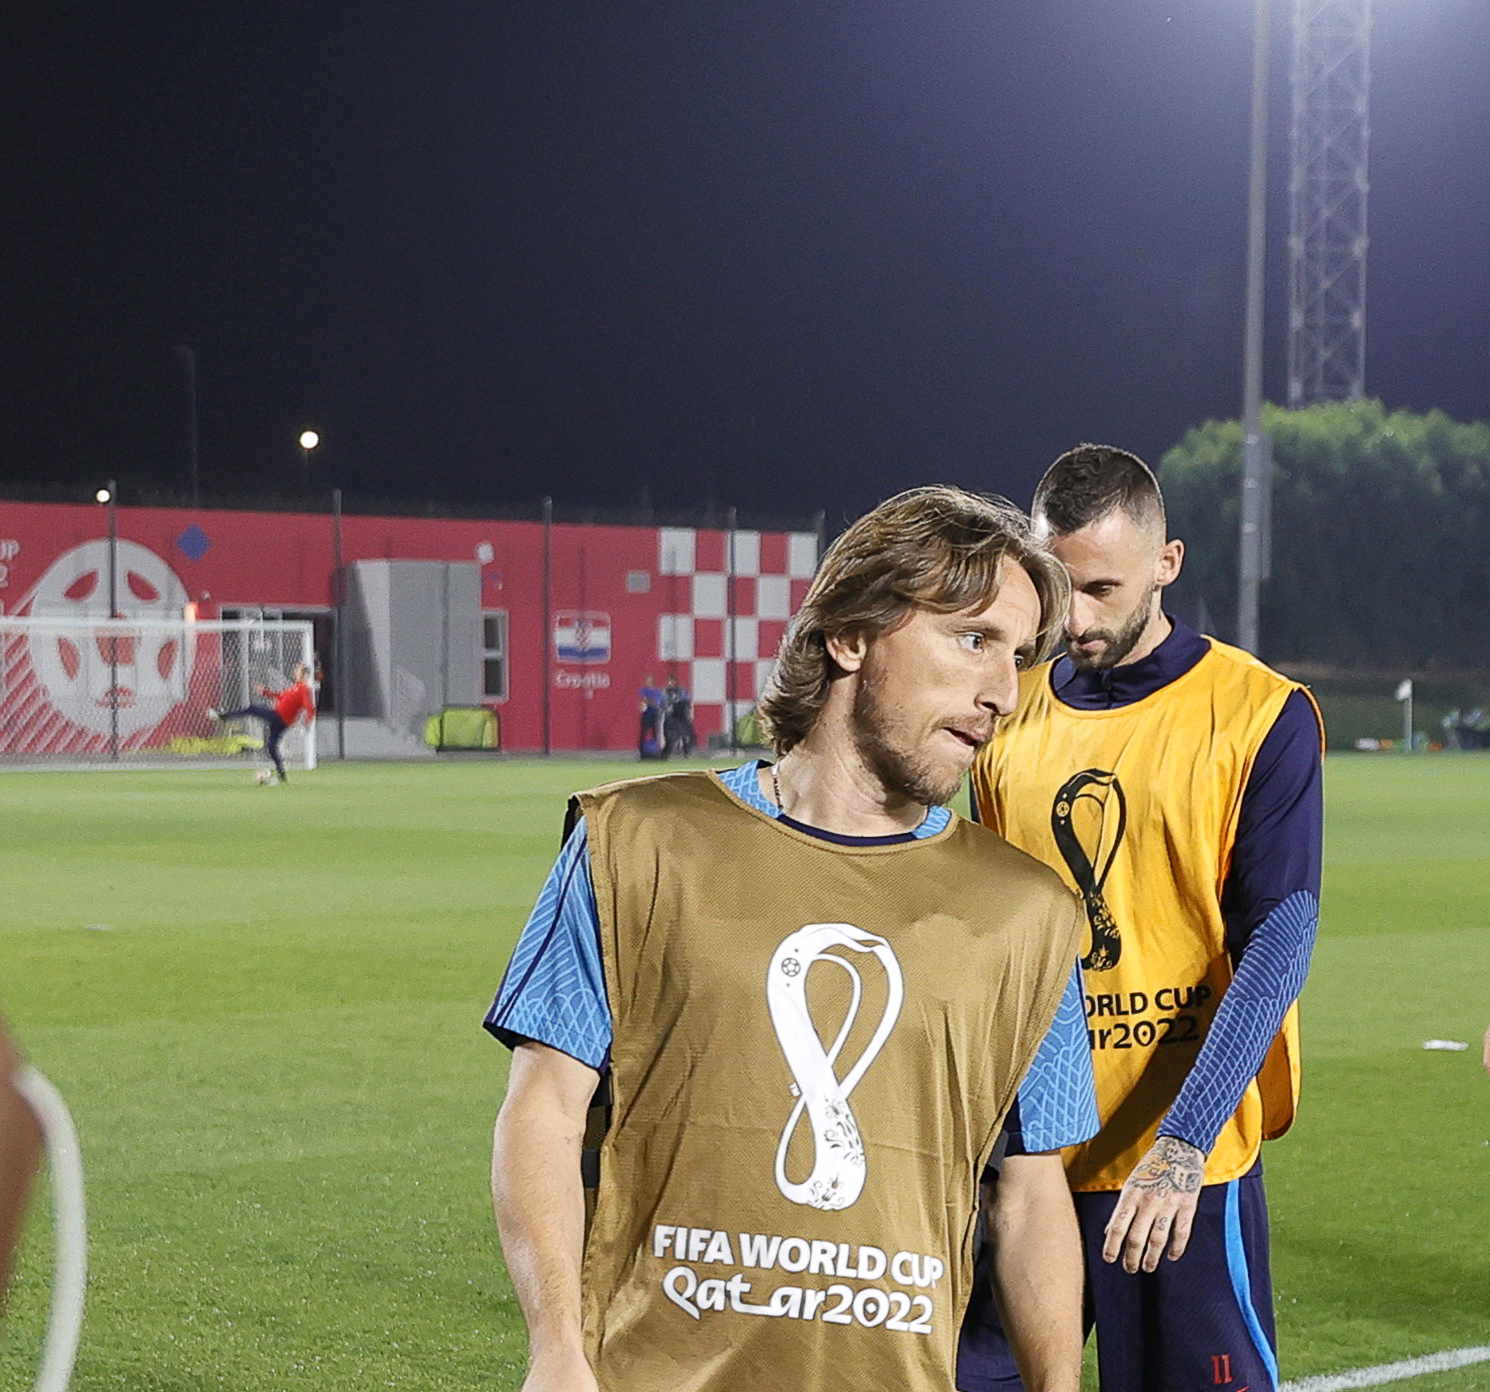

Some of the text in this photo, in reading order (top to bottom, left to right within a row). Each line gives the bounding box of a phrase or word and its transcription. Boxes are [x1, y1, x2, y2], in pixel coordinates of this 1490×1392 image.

[1155, 985, 1212, 1011] CUP
[1088, 1015, 1200, 1050] r2022
[653, 1224, 944, 1290] FIFA WORLD CUP
[1212, 1354, 1234, 1385] 11
